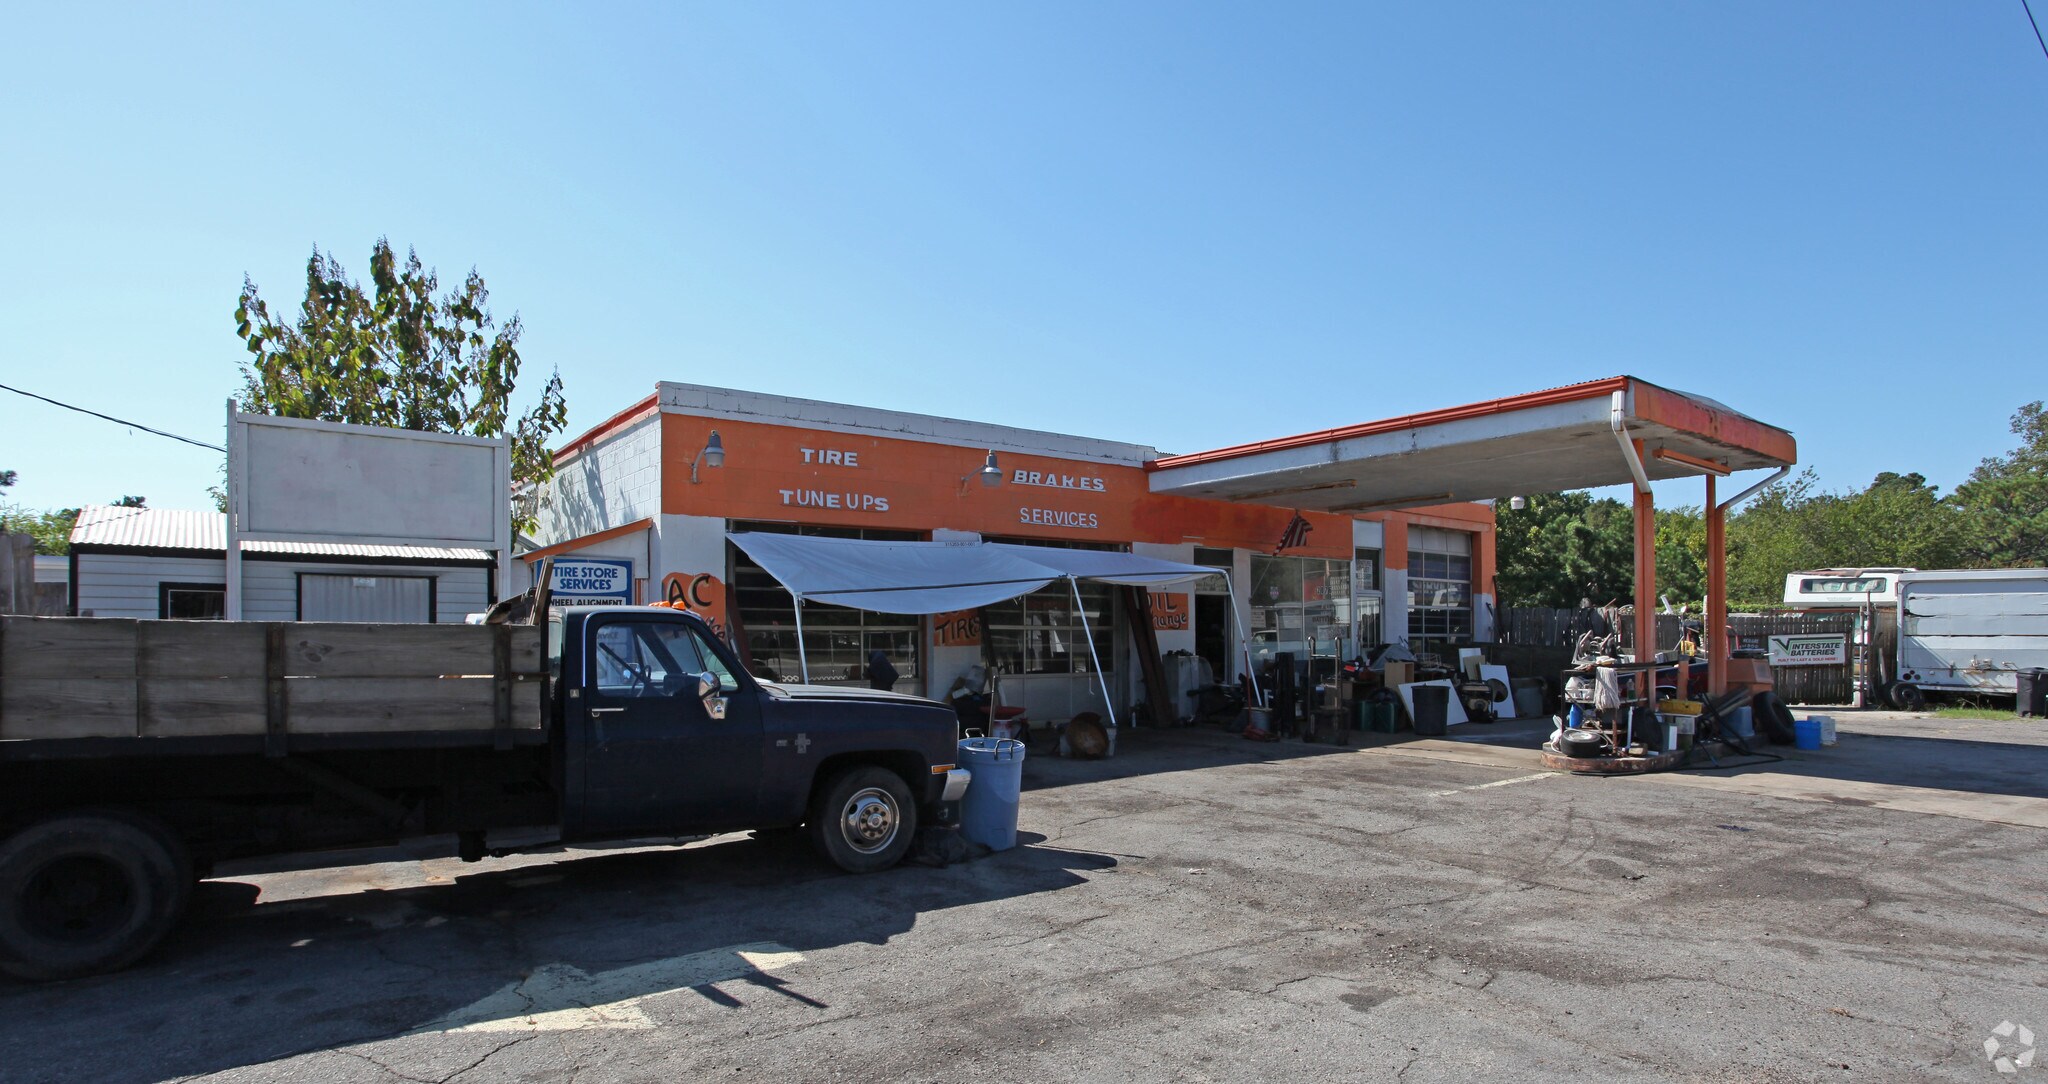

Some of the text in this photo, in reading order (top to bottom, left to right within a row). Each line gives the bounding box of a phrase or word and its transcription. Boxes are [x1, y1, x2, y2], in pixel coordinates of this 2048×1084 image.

[801, 448, 858, 467] TIRE
[1011, 469, 1107, 492] BRAKES
[780, 489, 890, 512] TUNE UPS
[1019, 507, 1098, 528] SERVICES
[552, 566, 619, 579] TIRE STORE
[559, 578, 612, 591] SERVICES
[666, 573, 712, 609] AC
[1152, 610, 1187, 629] hange
[1790, 649, 1836, 657] BATTERIES
[1791, 642, 1841, 650] INTERSTATE
